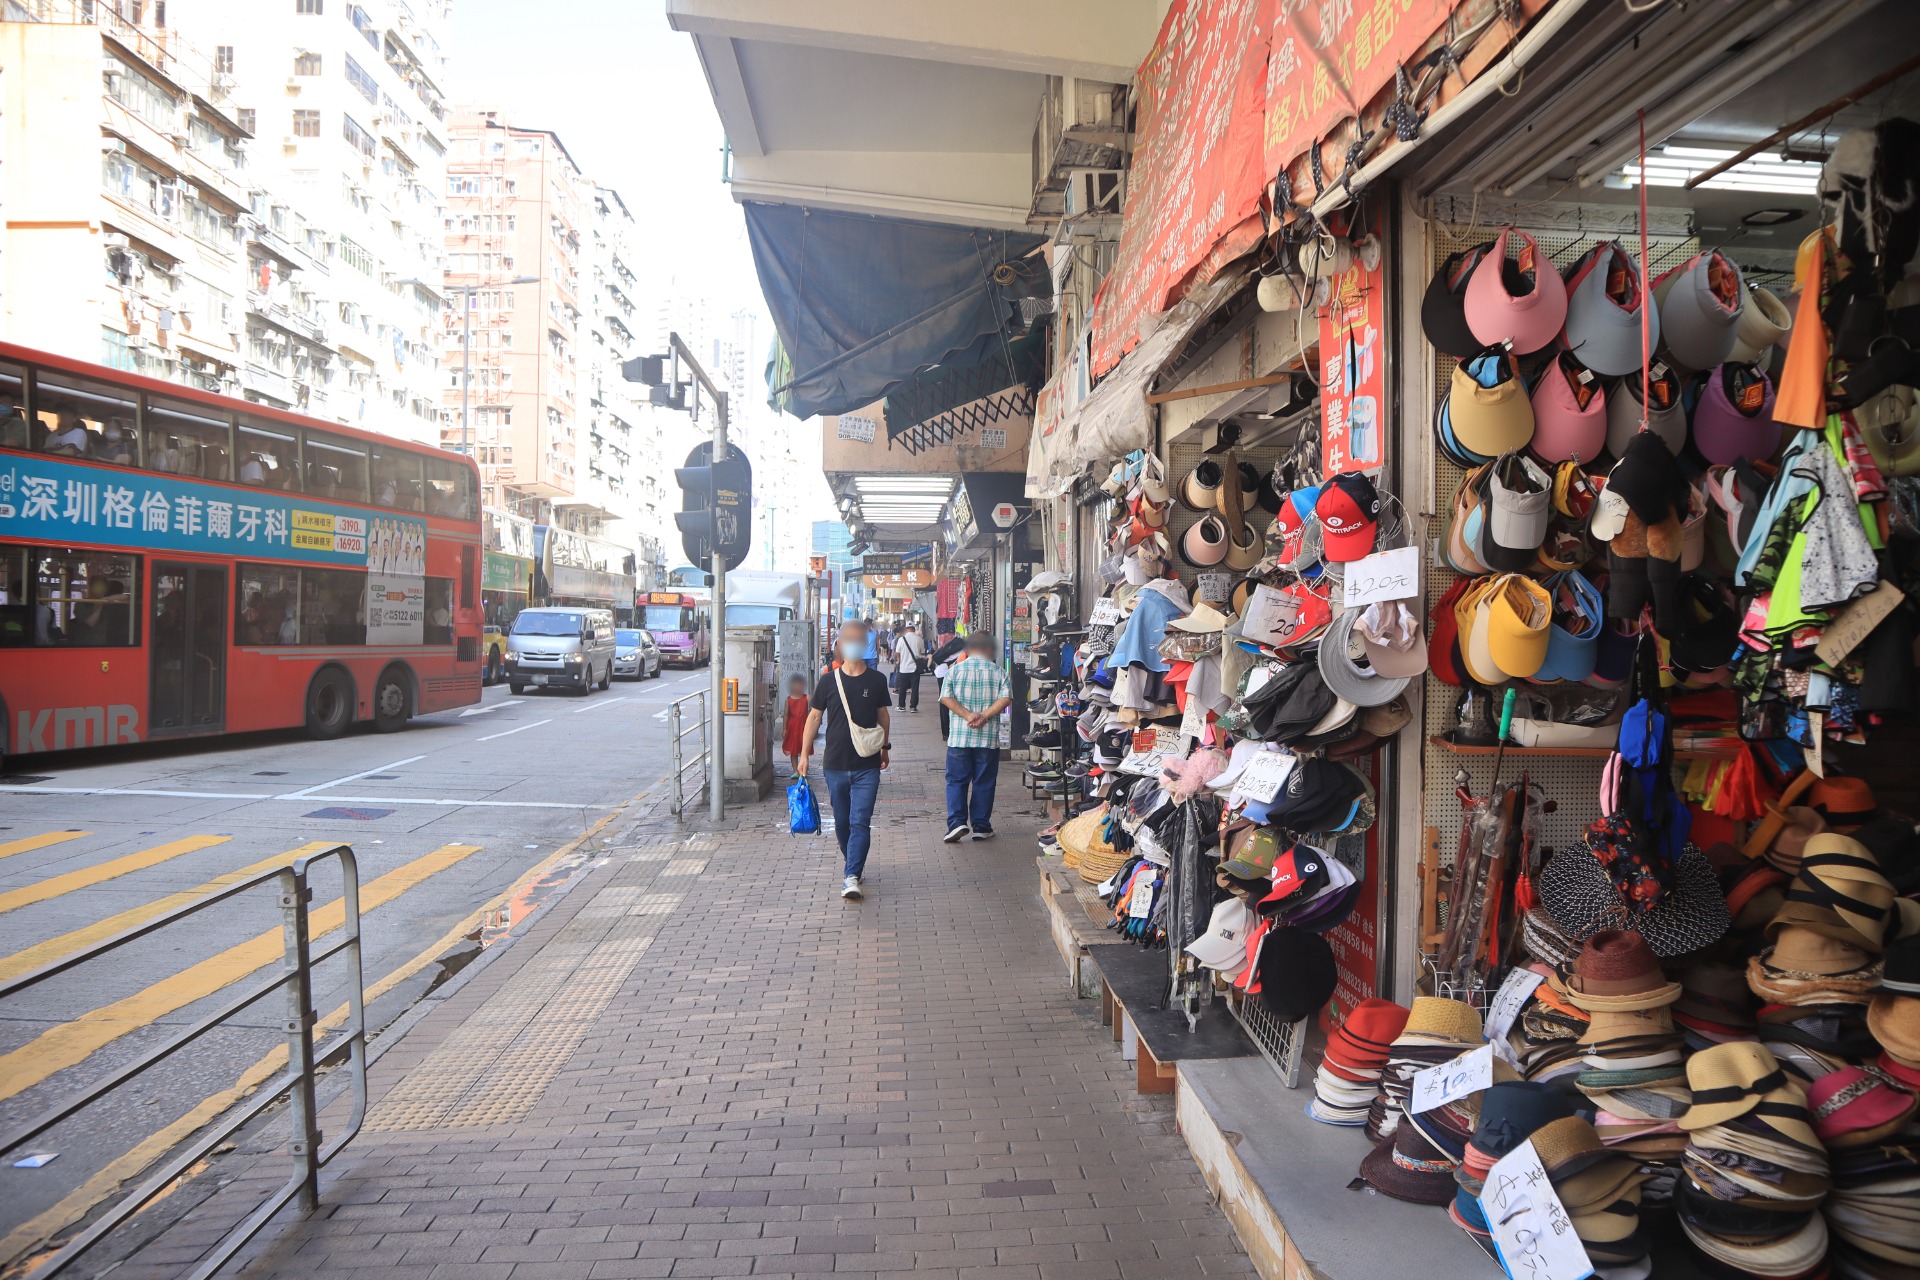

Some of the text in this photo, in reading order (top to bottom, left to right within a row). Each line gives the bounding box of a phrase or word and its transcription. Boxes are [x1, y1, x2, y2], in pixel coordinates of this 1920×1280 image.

[20, 474, 289, 546] 深圳格倫菲爾牙科
[1156, 729, 1181, 741] SOCKS
